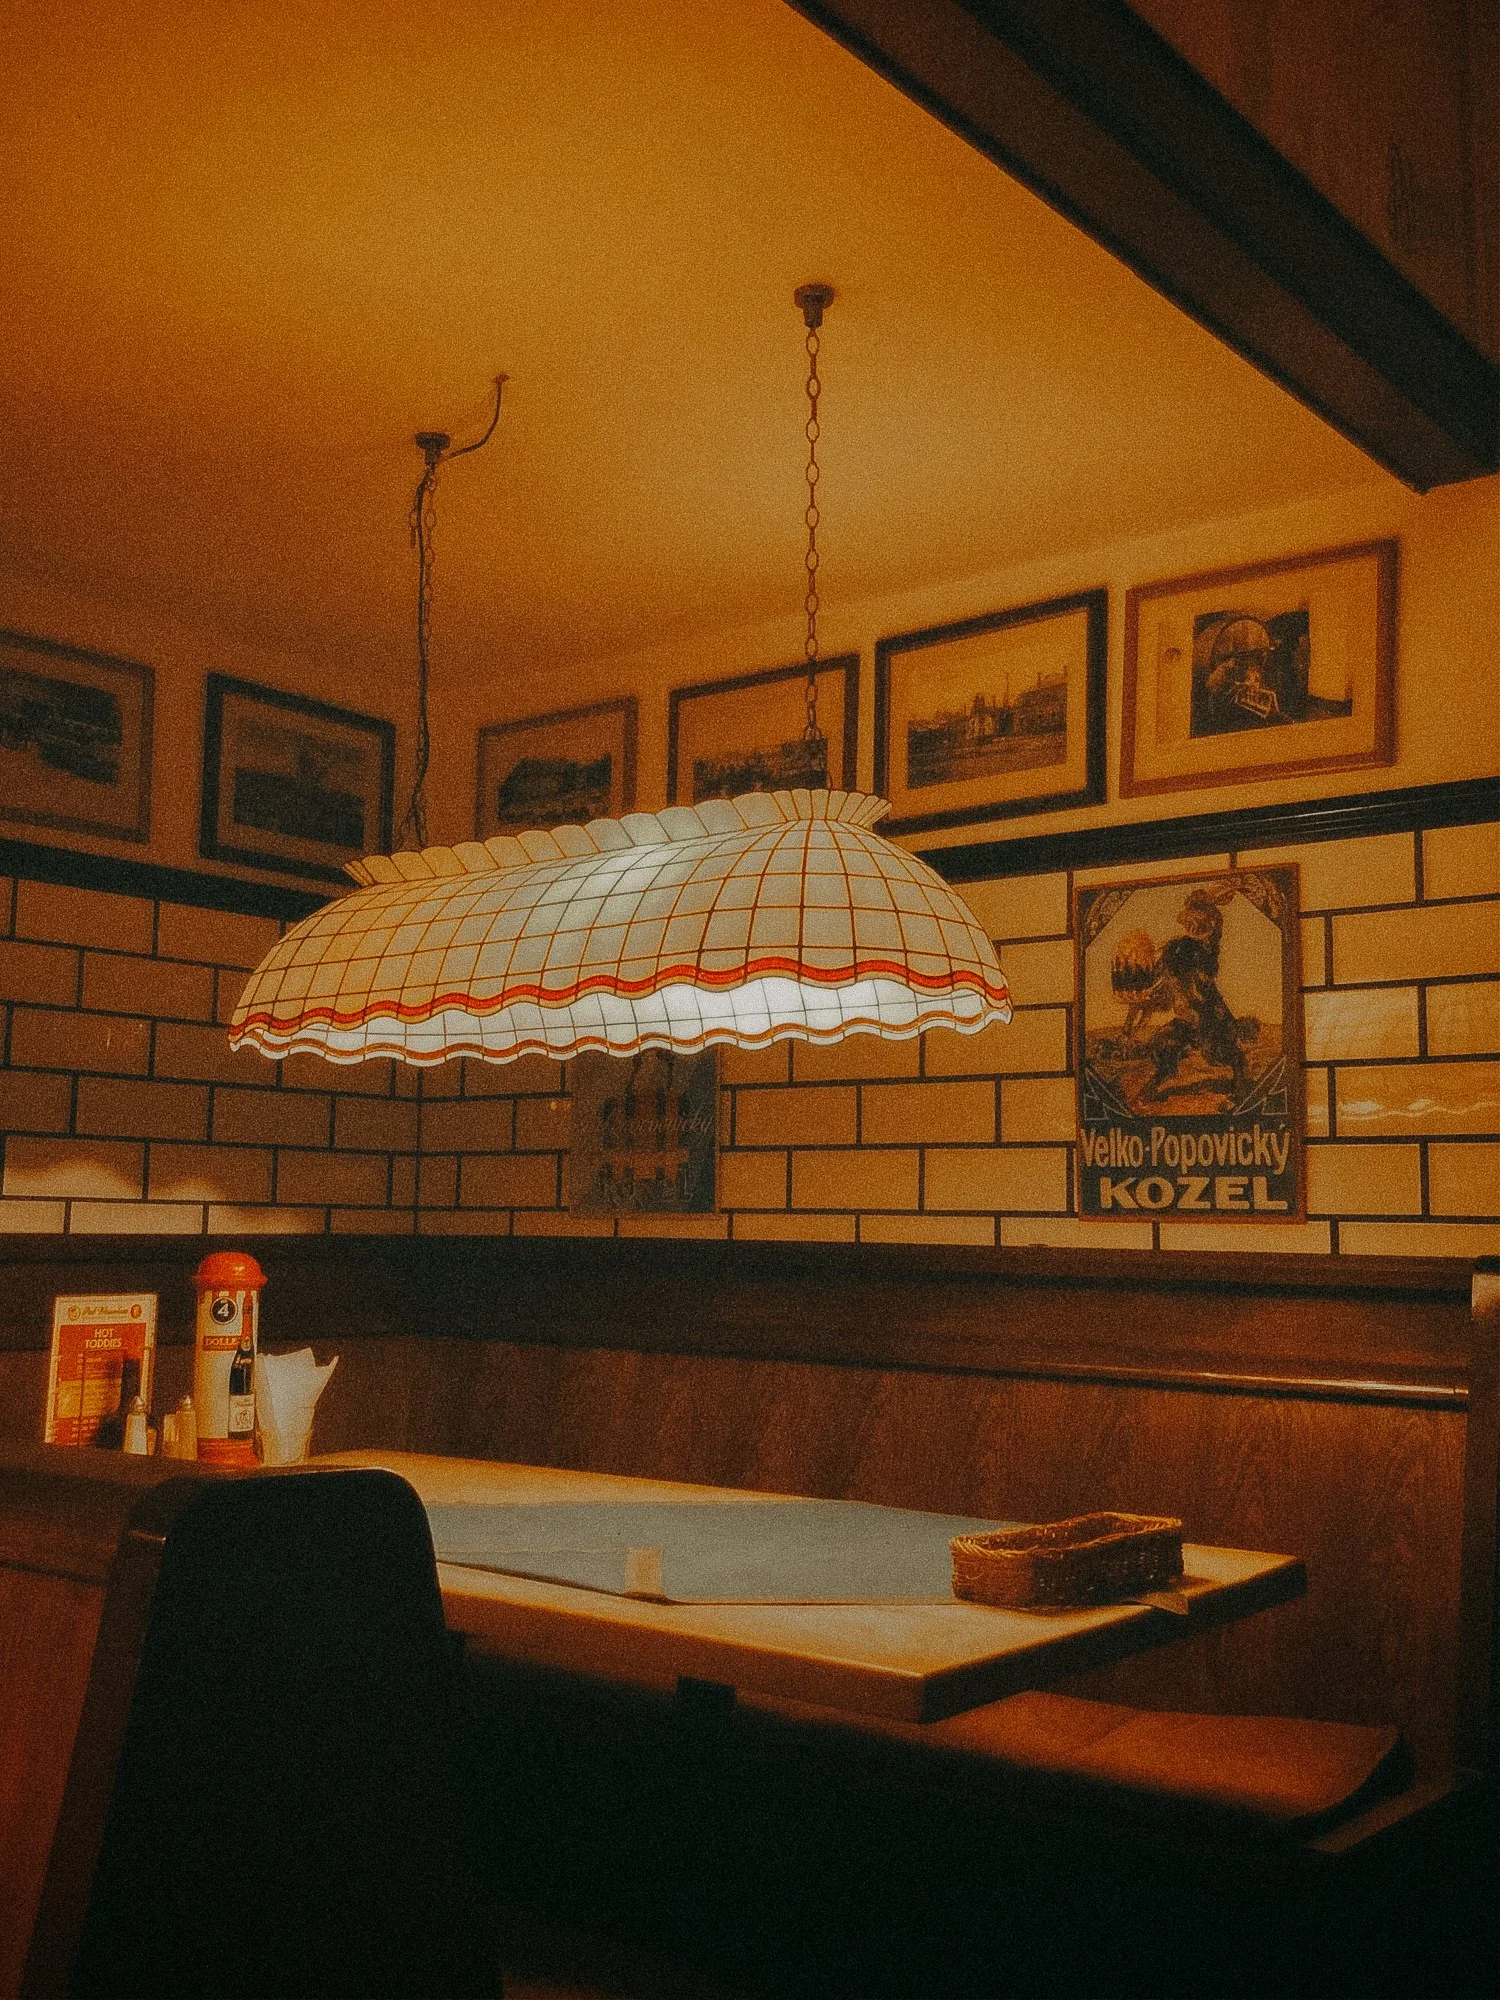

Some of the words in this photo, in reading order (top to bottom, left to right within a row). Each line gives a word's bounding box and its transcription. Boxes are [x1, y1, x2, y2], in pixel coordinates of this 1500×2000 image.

[1100, 1176, 1288, 1209] KOZEL
[217, 1303, 230, 1317] 4
[94, 1328, 115, 1338] HOT
[85, 1338, 122, 1348] TODDIES
